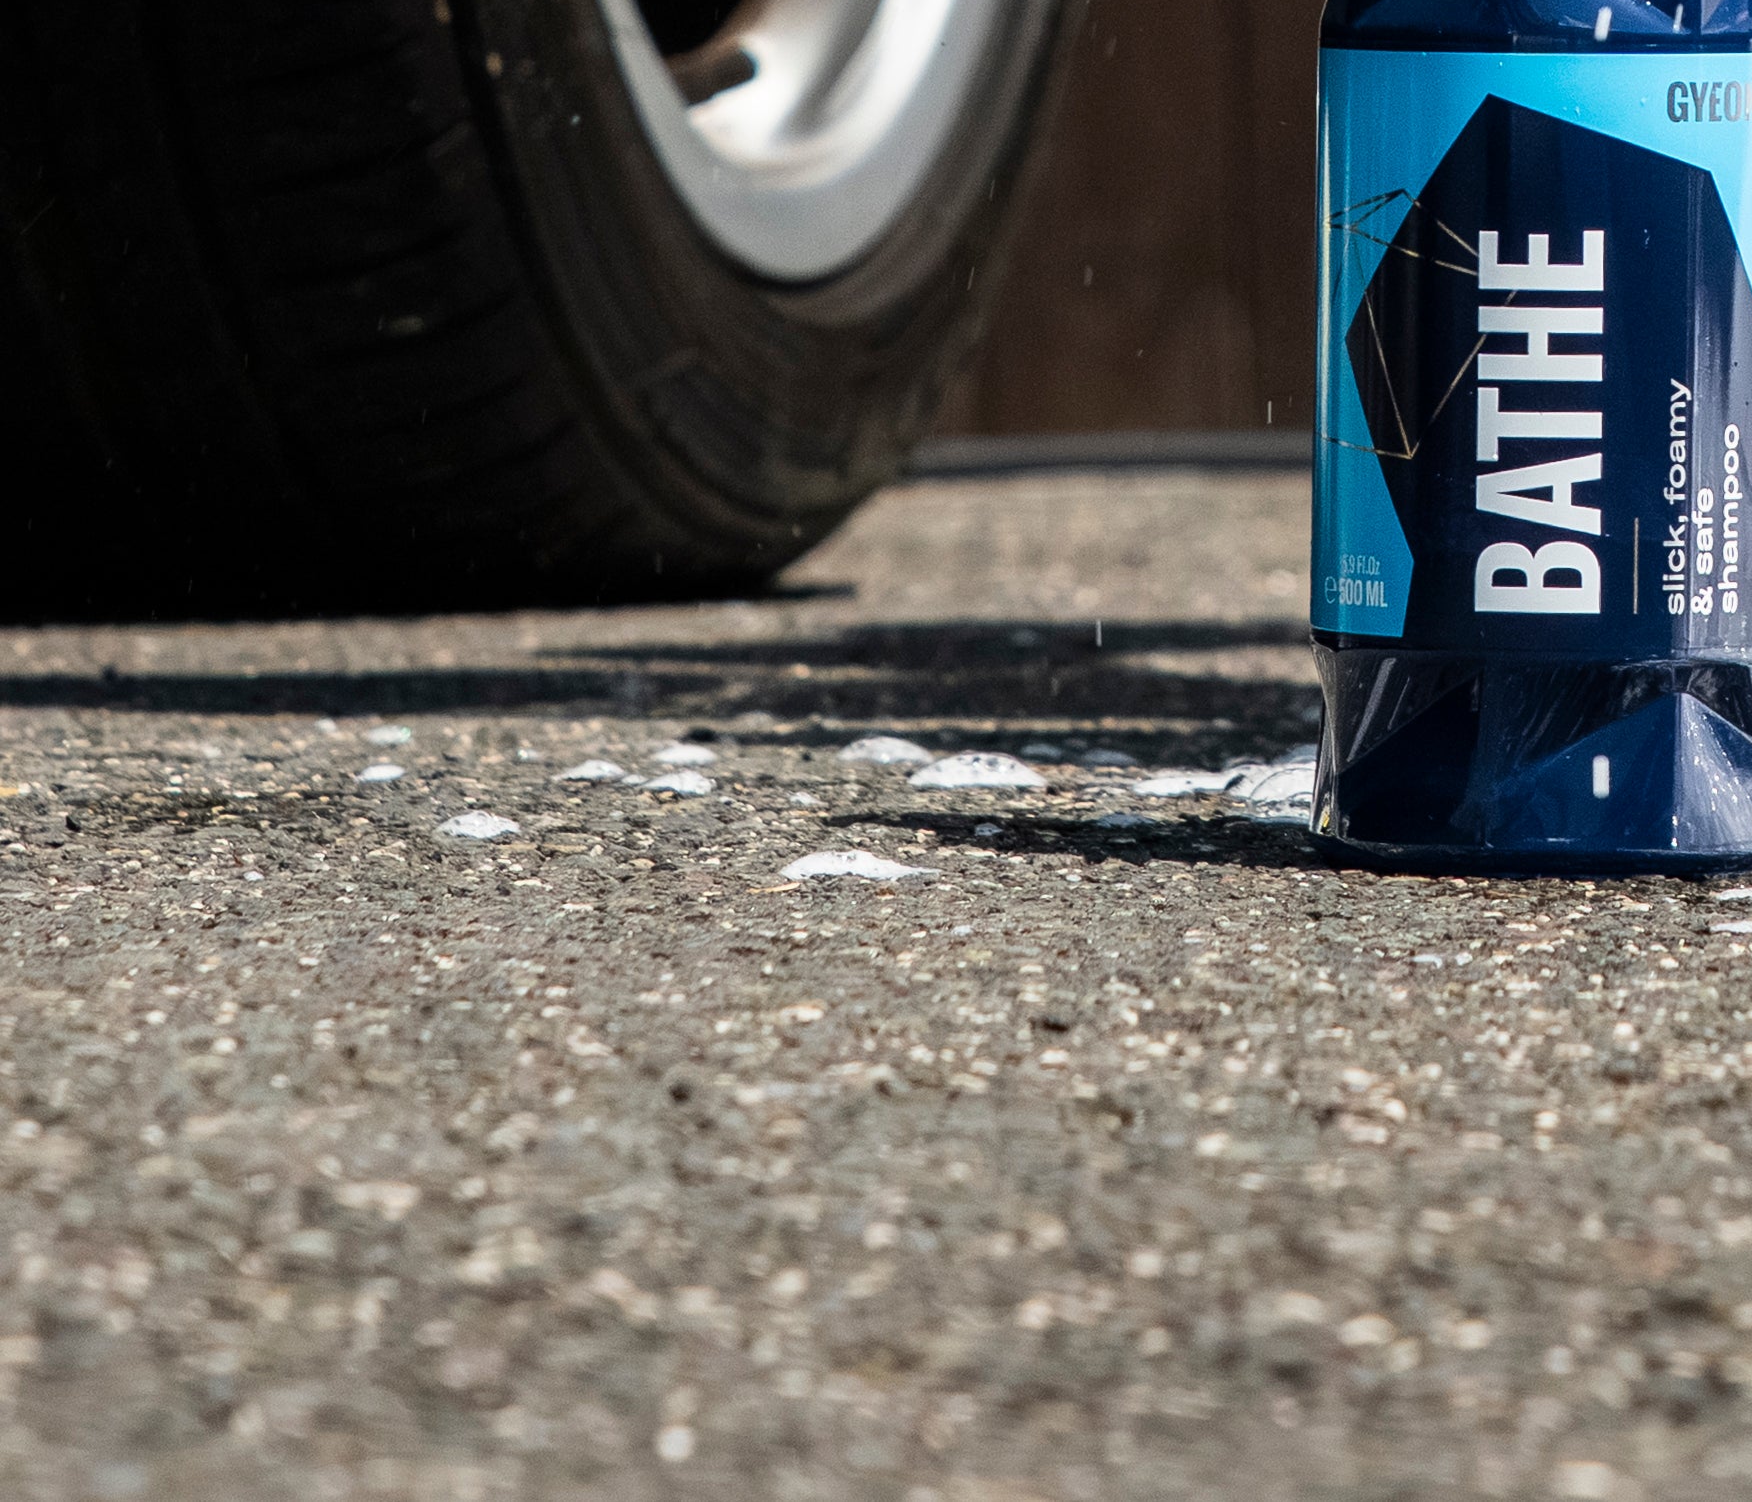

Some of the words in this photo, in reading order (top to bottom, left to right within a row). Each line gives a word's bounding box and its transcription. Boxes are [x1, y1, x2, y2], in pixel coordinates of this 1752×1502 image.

[1474, 229, 1605, 614] BATHE
[1663, 377, 1692, 506] foamy
[1662, 514, 1689, 616] slick,
[1691, 487, 1714, 576] safe
[1717, 423, 1743, 614] shampoo
[1365, 579, 1389, 608] ML
[1690, 585, 1714, 616] &
